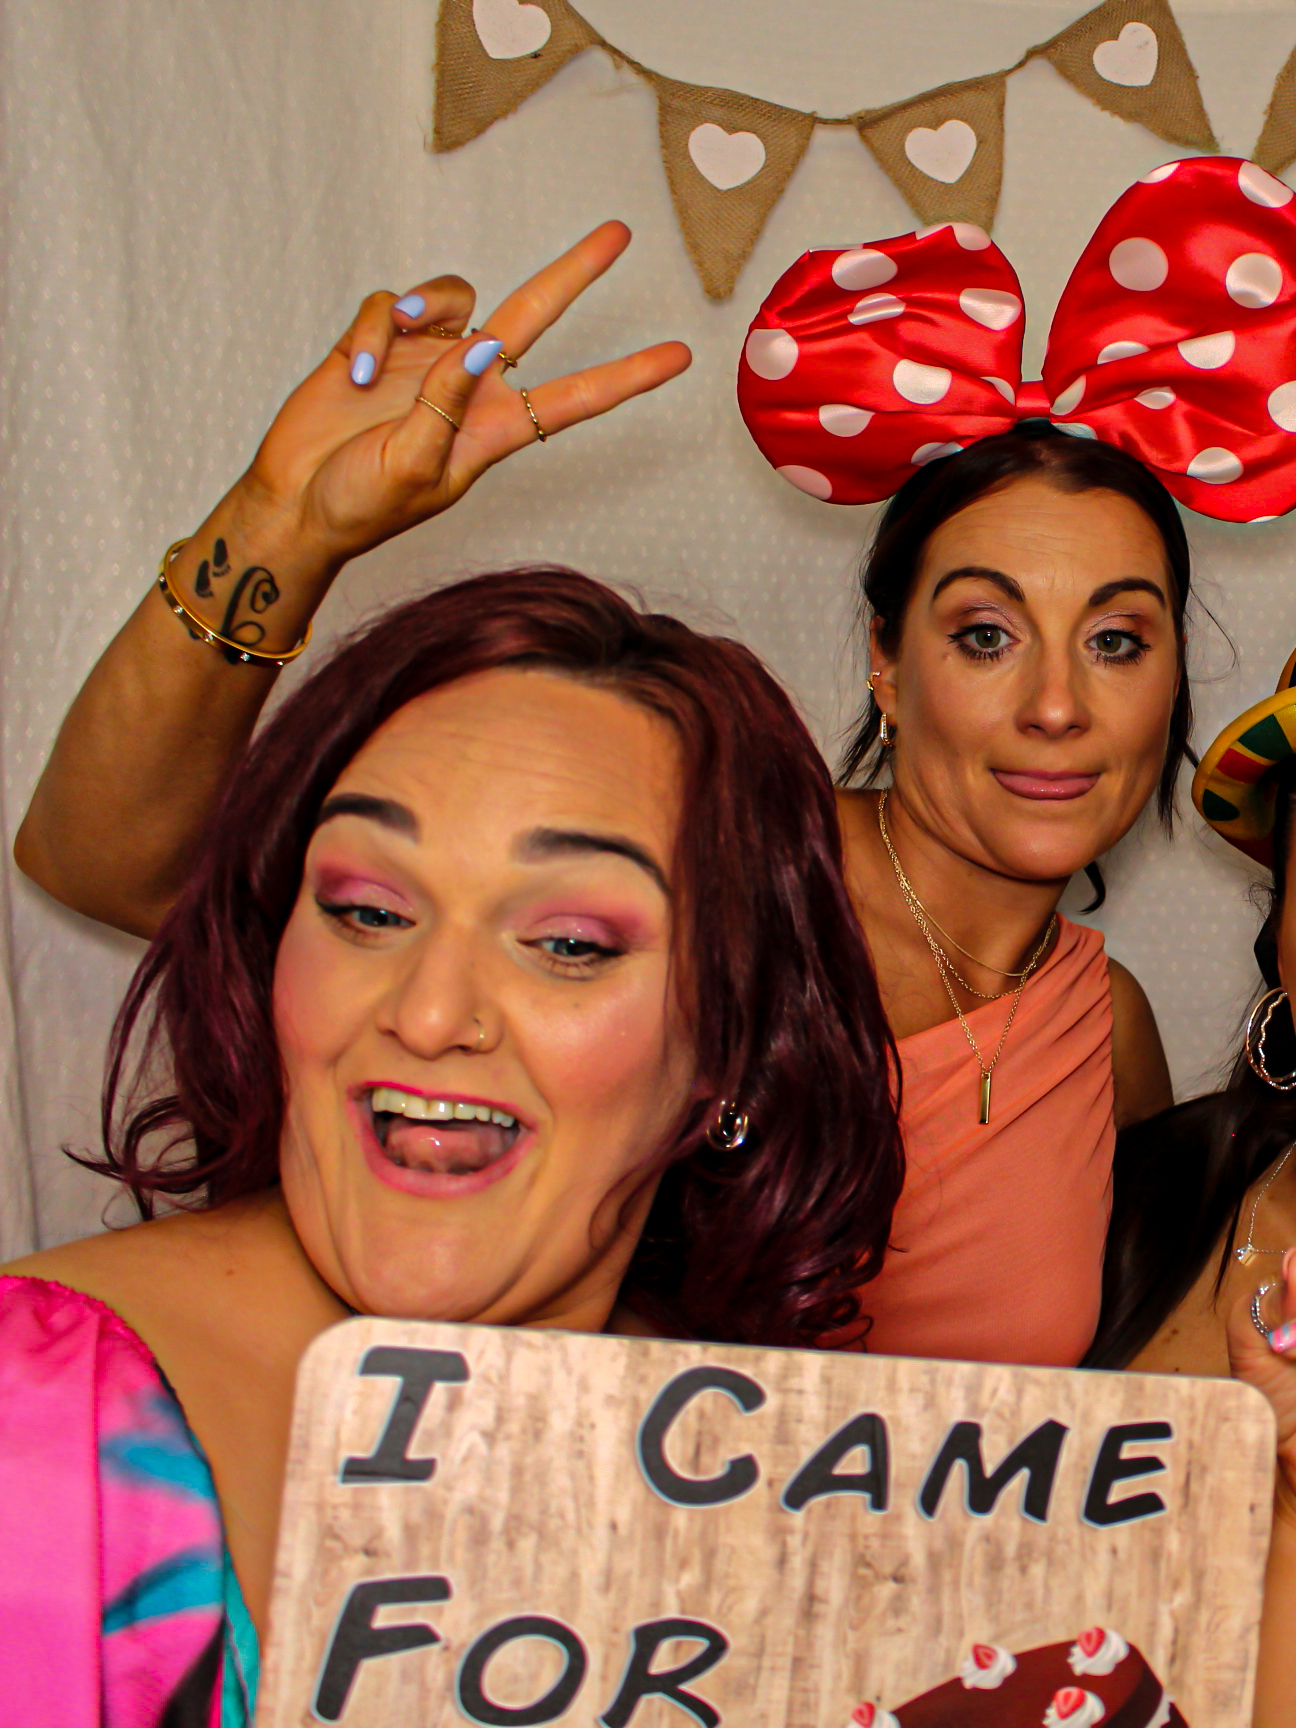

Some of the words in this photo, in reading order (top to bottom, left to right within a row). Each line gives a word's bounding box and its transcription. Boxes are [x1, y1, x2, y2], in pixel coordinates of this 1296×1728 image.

[340, 1345, 470, 1484] I
[638, 1366, 1174, 1528] CAME
[312, 1575, 731, 1728] FOR
